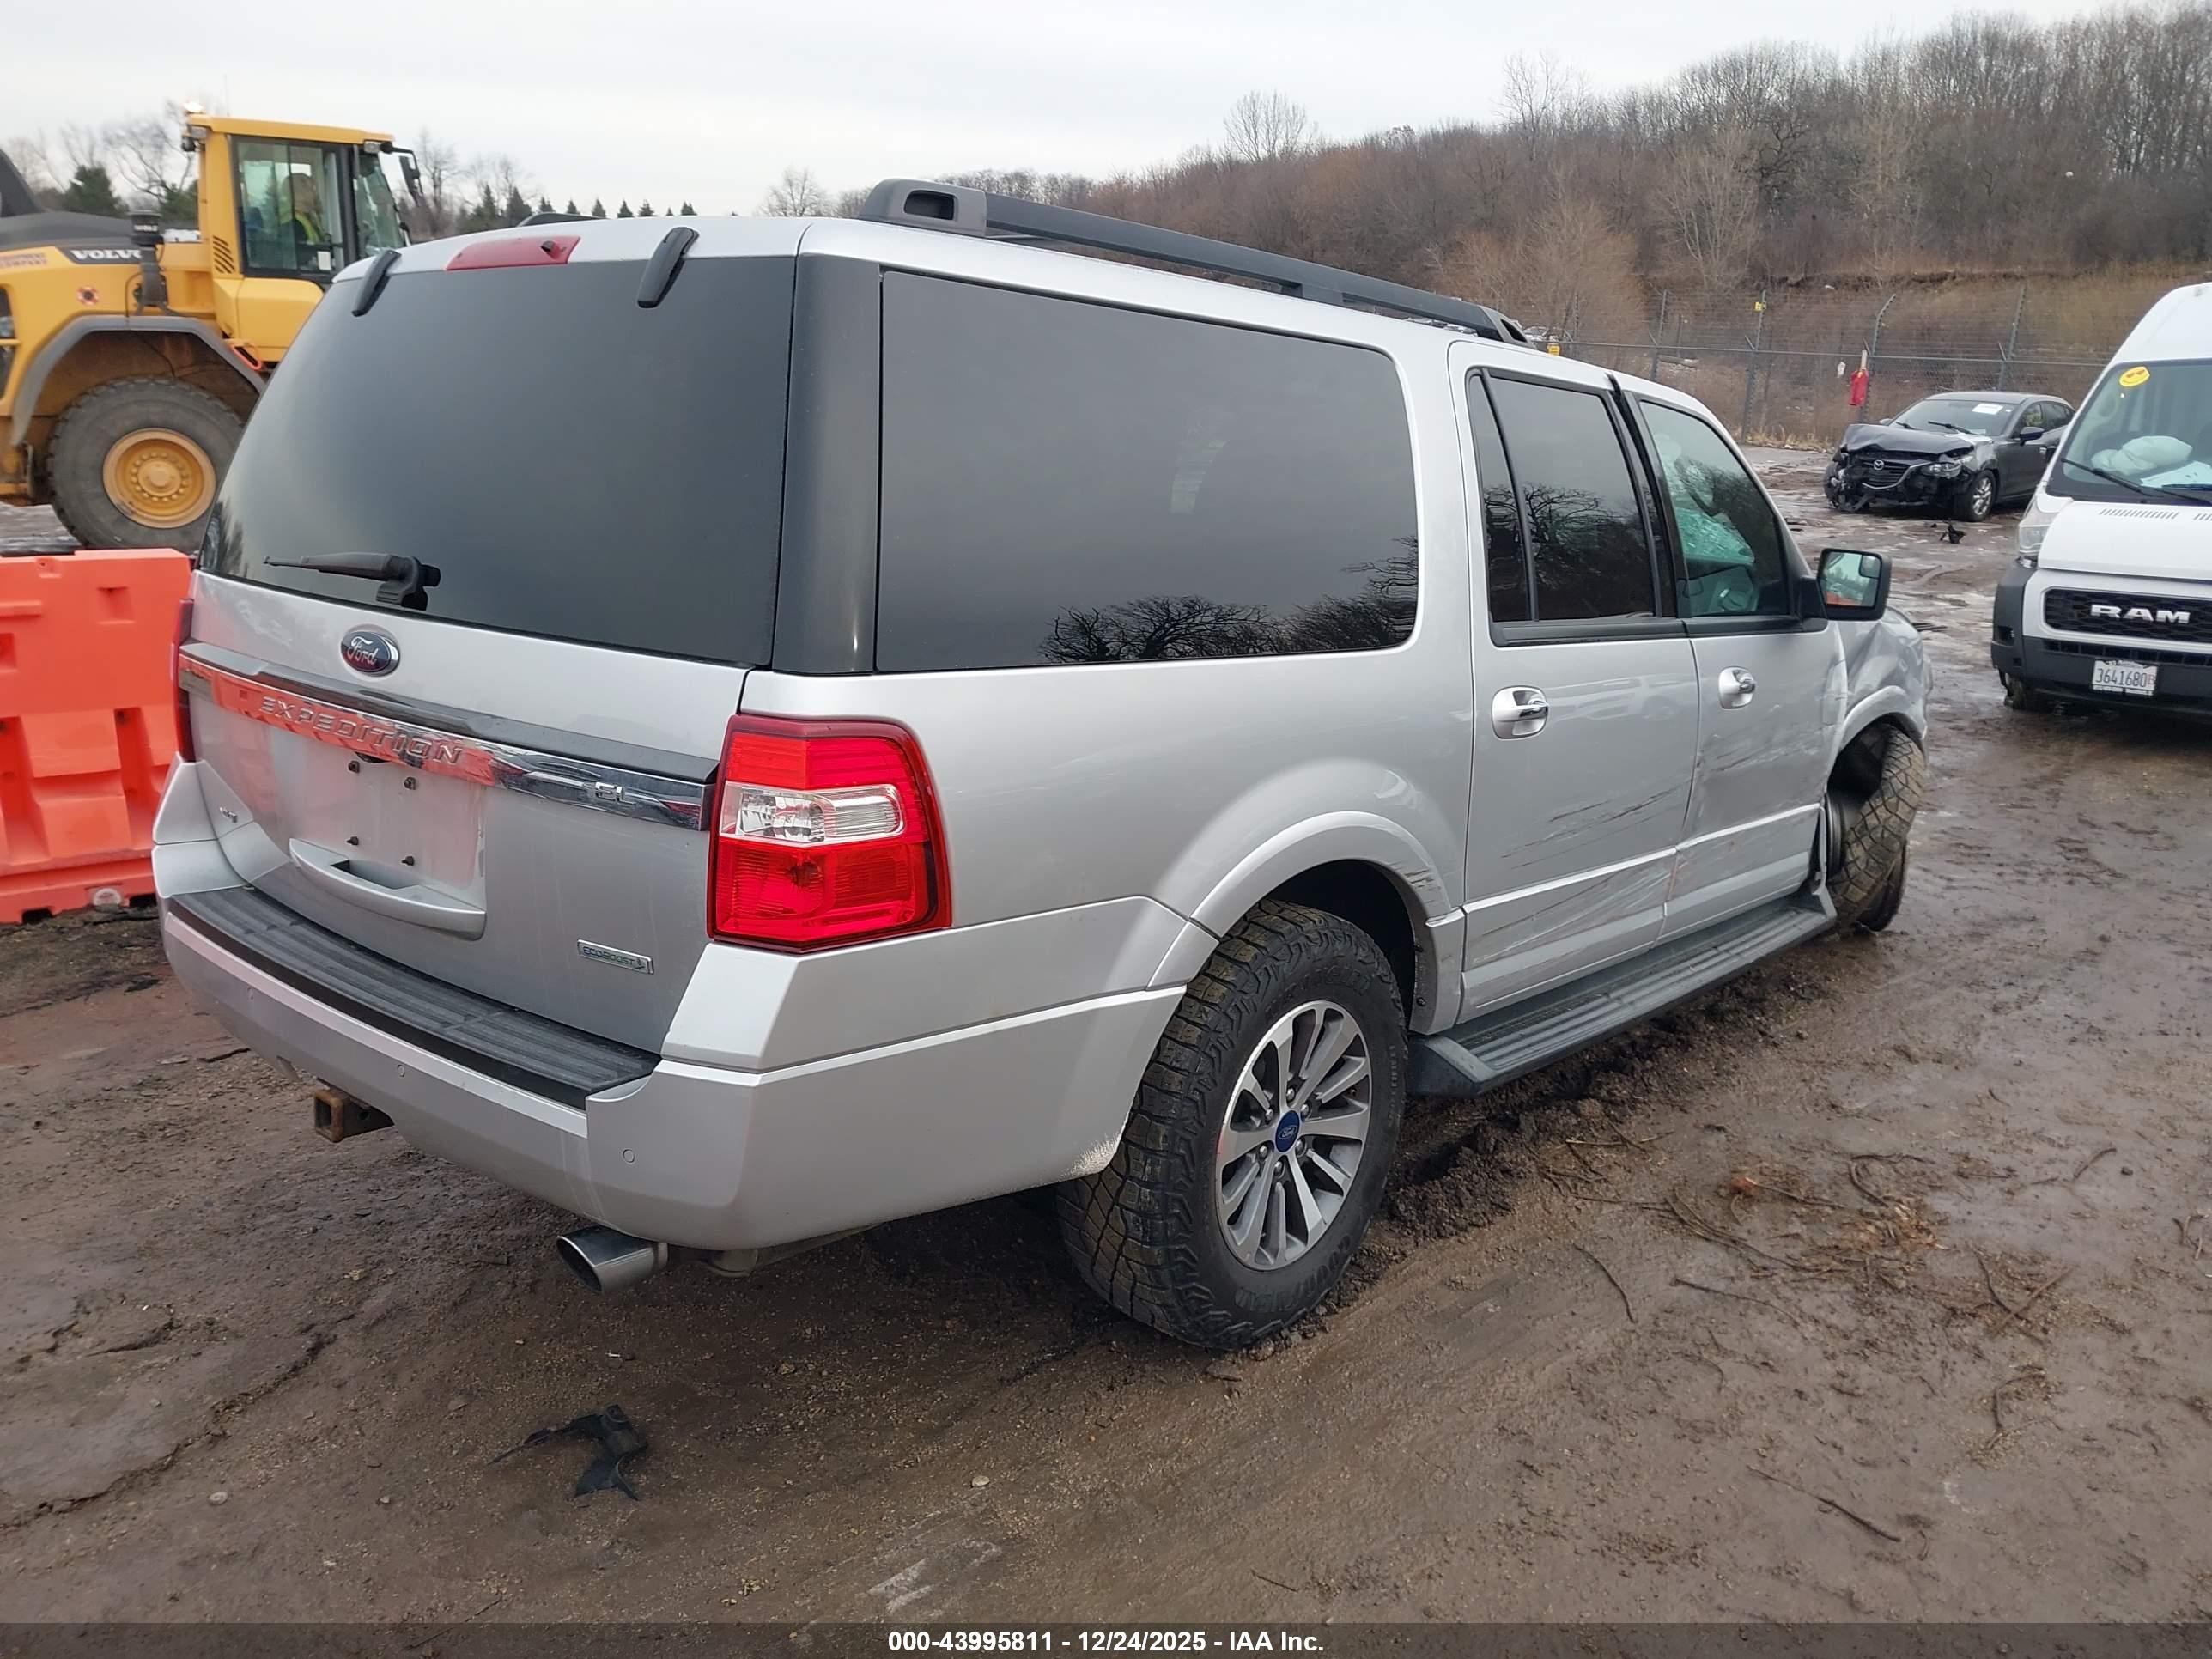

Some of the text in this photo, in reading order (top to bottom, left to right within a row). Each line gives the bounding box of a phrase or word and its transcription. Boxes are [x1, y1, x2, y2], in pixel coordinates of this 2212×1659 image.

[2090, 605, 2191, 624] RAM
[347, 635, 380, 665] Ford
[259, 696, 464, 765] EXPEDITION
[594, 781, 636, 804] EL
